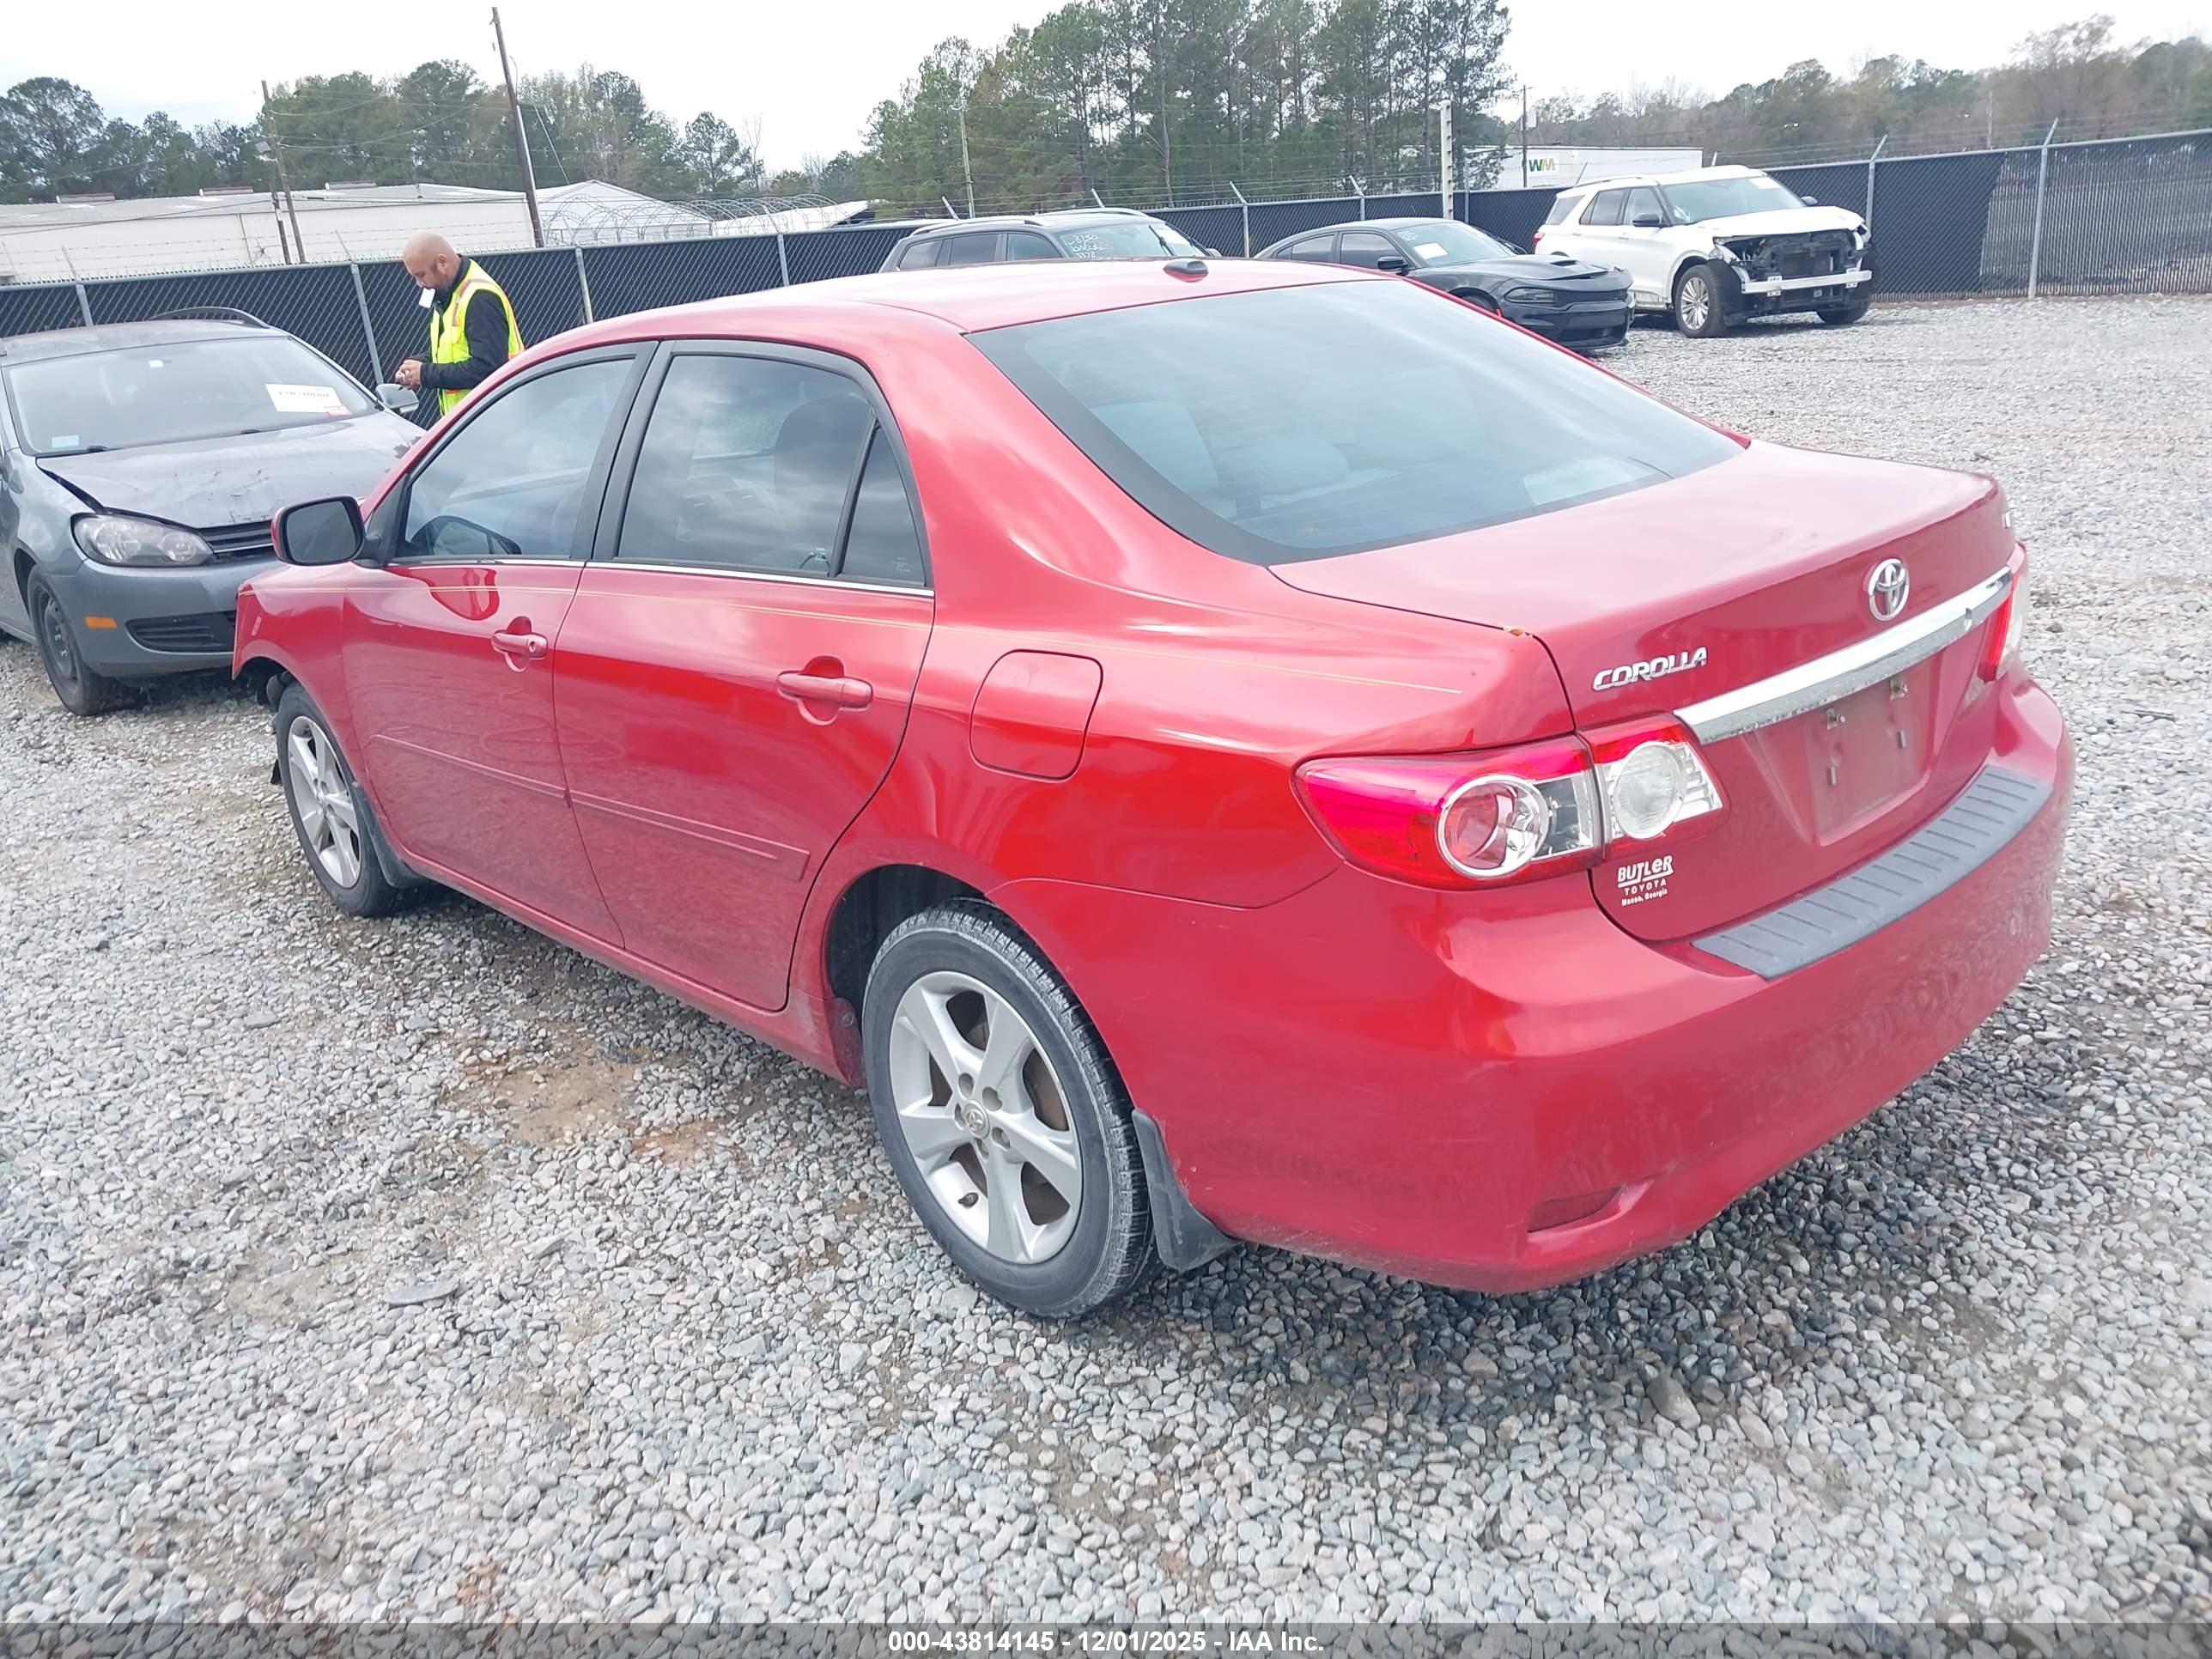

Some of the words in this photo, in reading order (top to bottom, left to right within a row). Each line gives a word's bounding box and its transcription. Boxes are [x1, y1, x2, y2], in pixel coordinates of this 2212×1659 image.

[1528, 158, 1555, 172] WM
[1593, 647, 1707, 690] COROLLA
[1625, 878, 1666, 896] TOYOTA
[1644, 888, 1668, 901] Georgia
